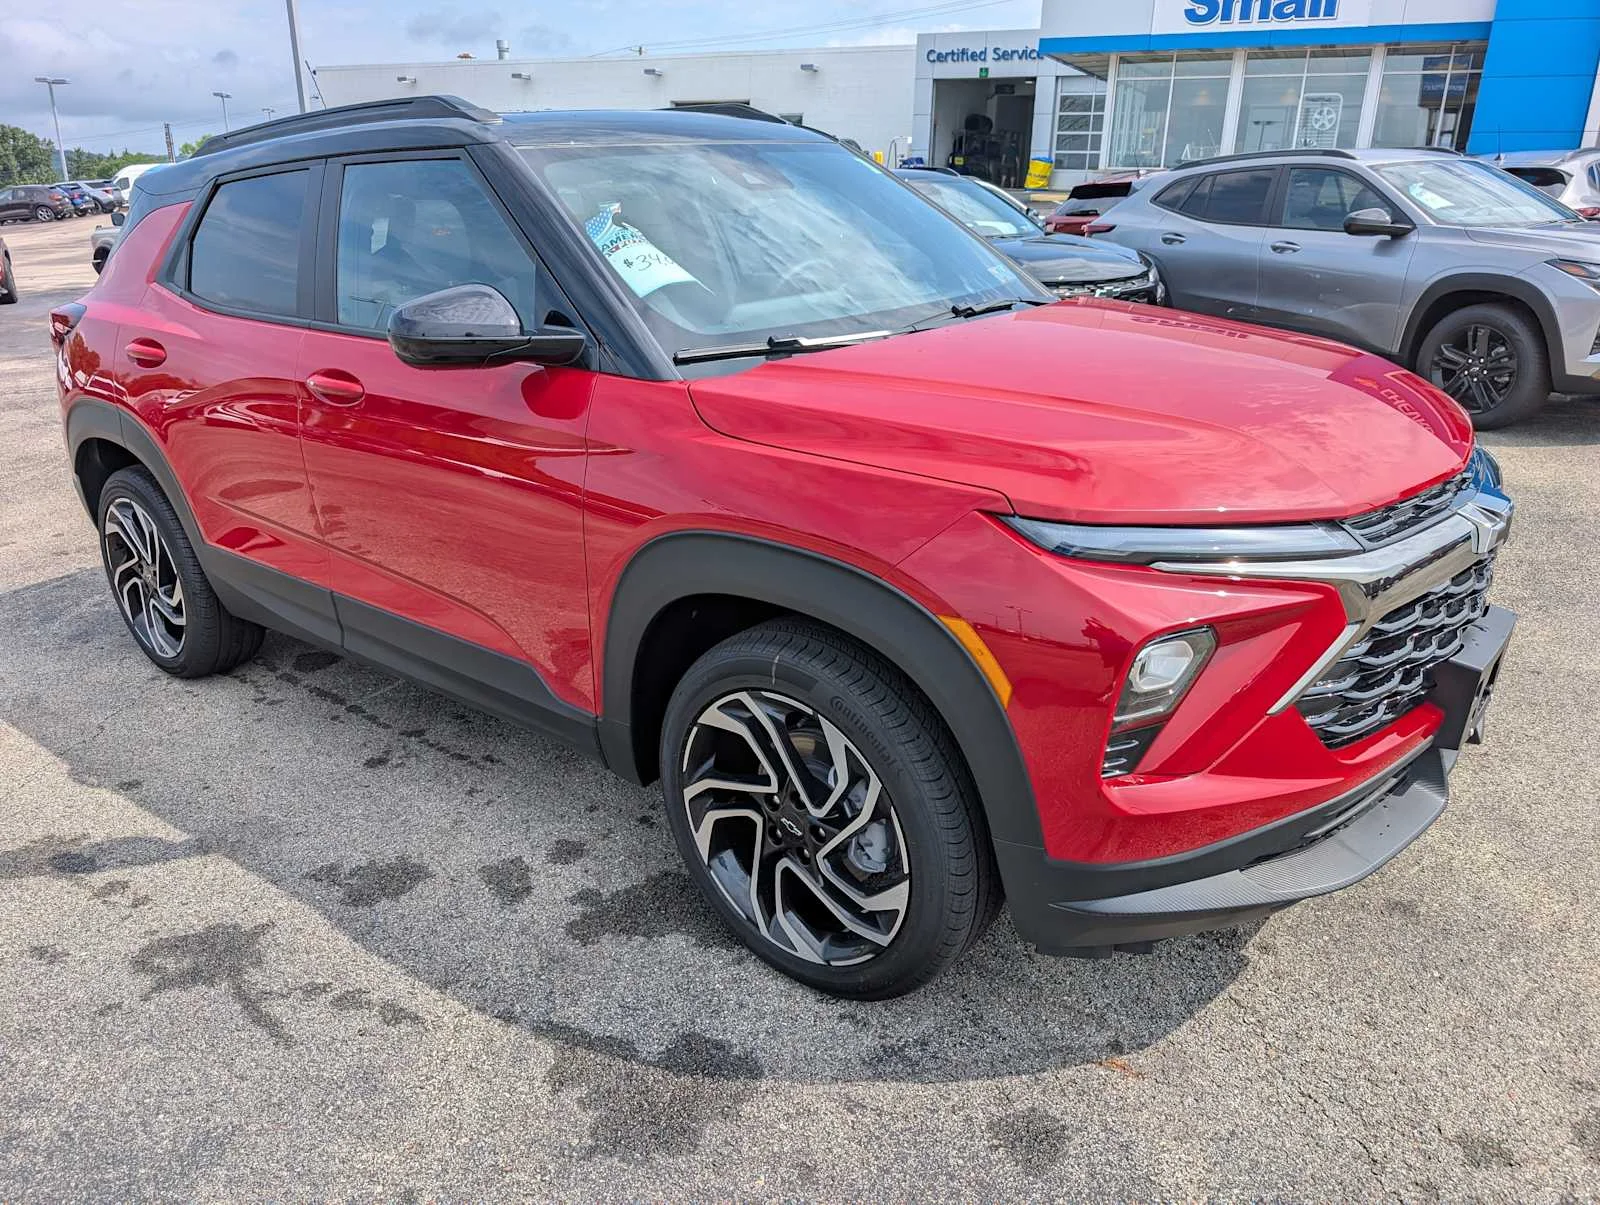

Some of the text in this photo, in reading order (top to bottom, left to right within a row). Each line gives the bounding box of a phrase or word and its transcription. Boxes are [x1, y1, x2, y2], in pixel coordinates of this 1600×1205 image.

[1184, 0, 1338, 25] Small
[926, 47, 987, 63] Certified
[830, 695, 898, 768] Continental
